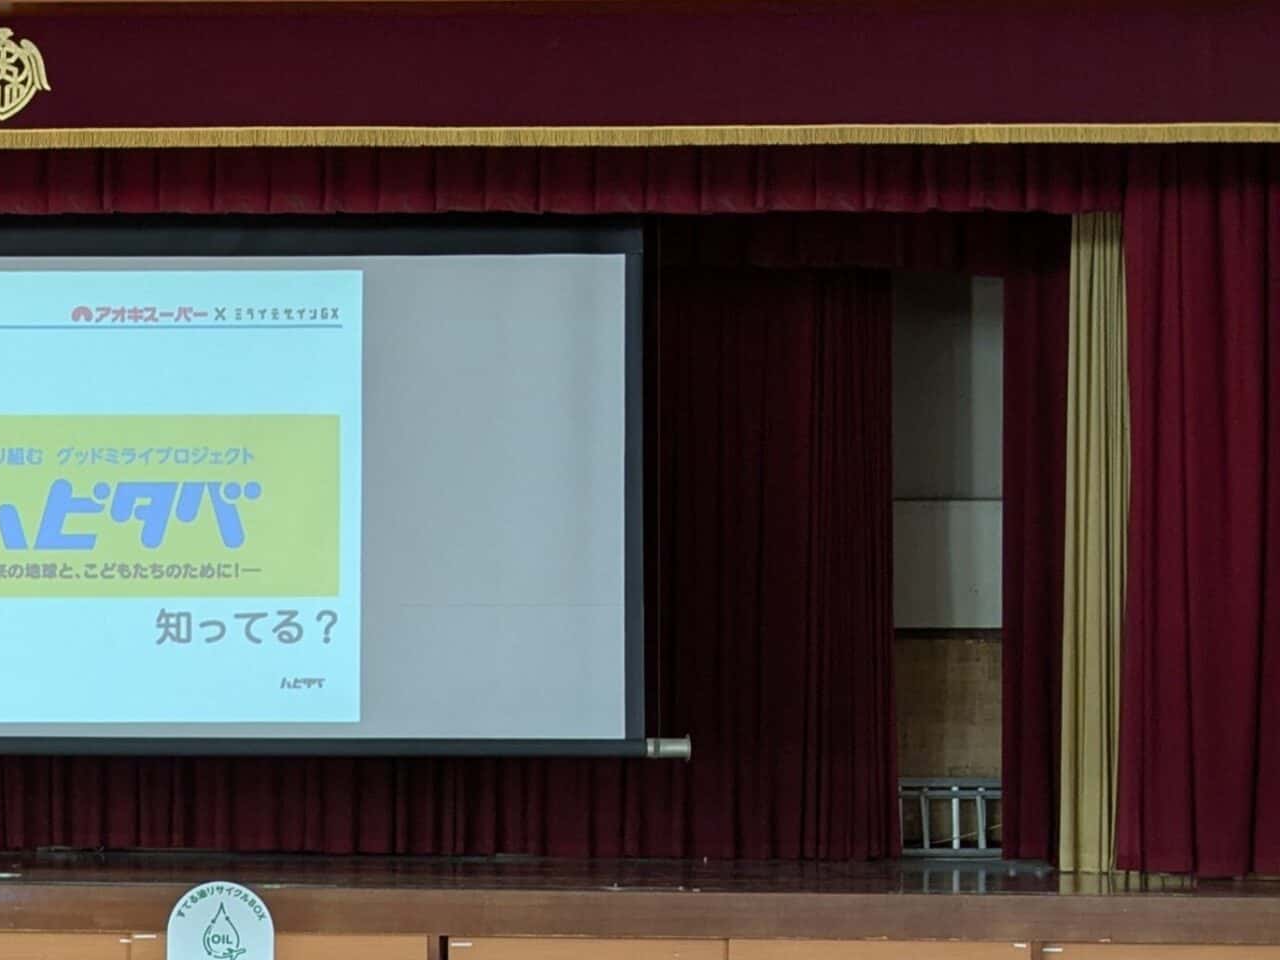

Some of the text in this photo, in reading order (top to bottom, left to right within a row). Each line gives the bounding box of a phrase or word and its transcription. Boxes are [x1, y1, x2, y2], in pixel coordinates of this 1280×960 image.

[95, 306, 208, 322] アオキスーパー
[57, 447, 254, 465] グッドミライプロジェクト
[156, 608, 338, 645] 知ってる？
[211, 934, 233, 945] OIL
